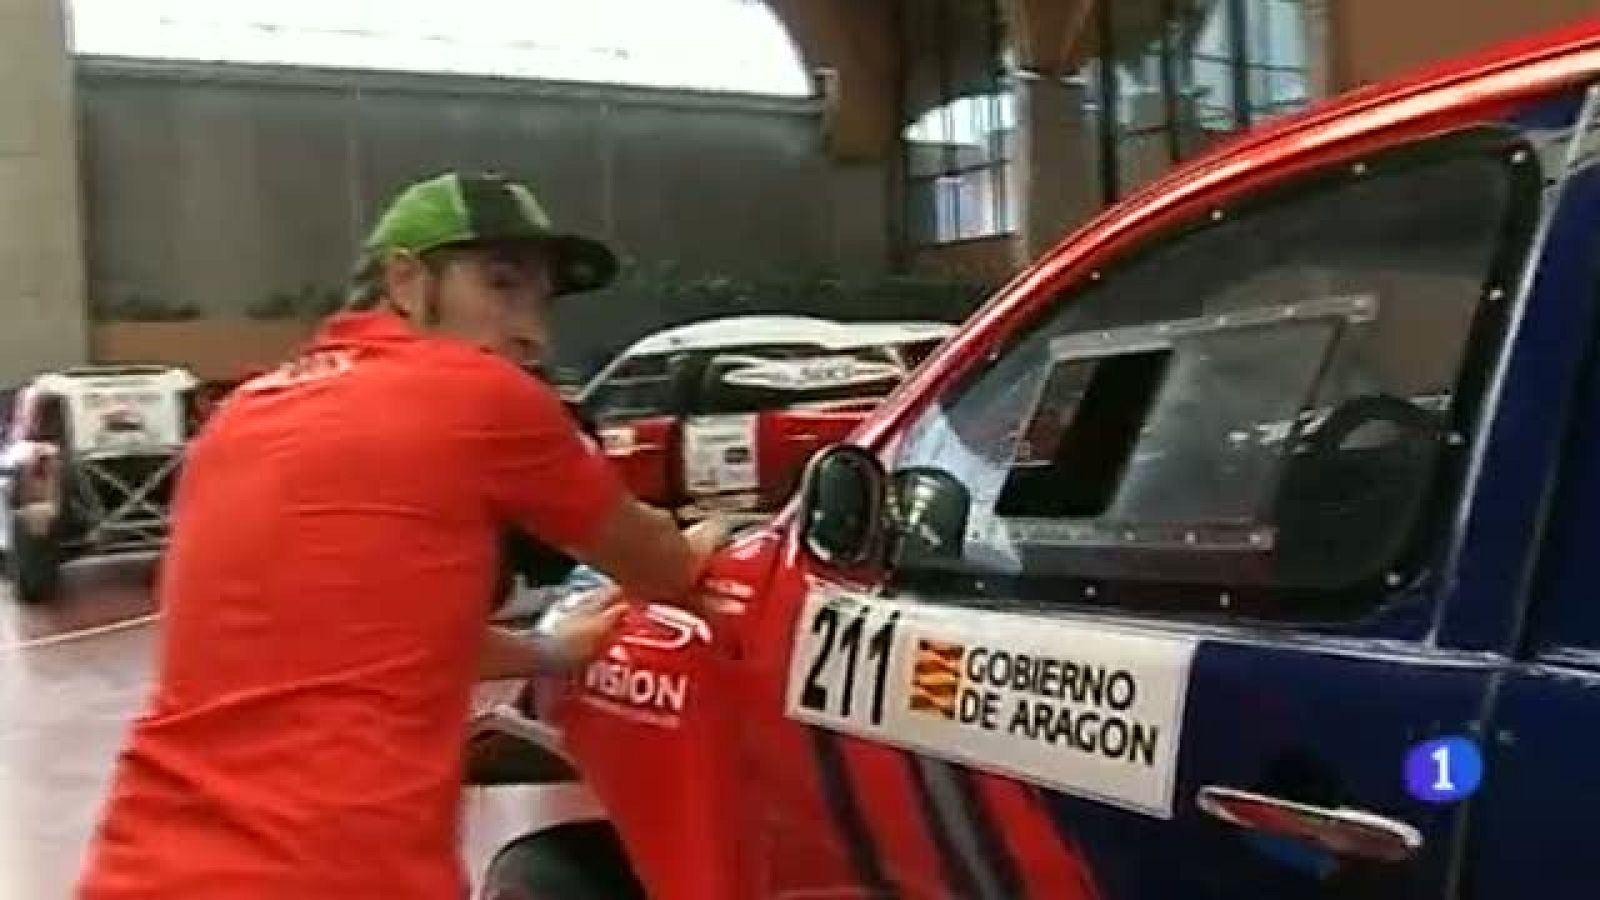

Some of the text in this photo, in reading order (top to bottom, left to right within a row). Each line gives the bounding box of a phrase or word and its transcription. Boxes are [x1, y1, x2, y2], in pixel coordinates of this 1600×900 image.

[801, 604, 901, 725] 211
[966, 646, 1136, 711] GOBIERNO
[959, 689, 1159, 766] DE ARAGON
